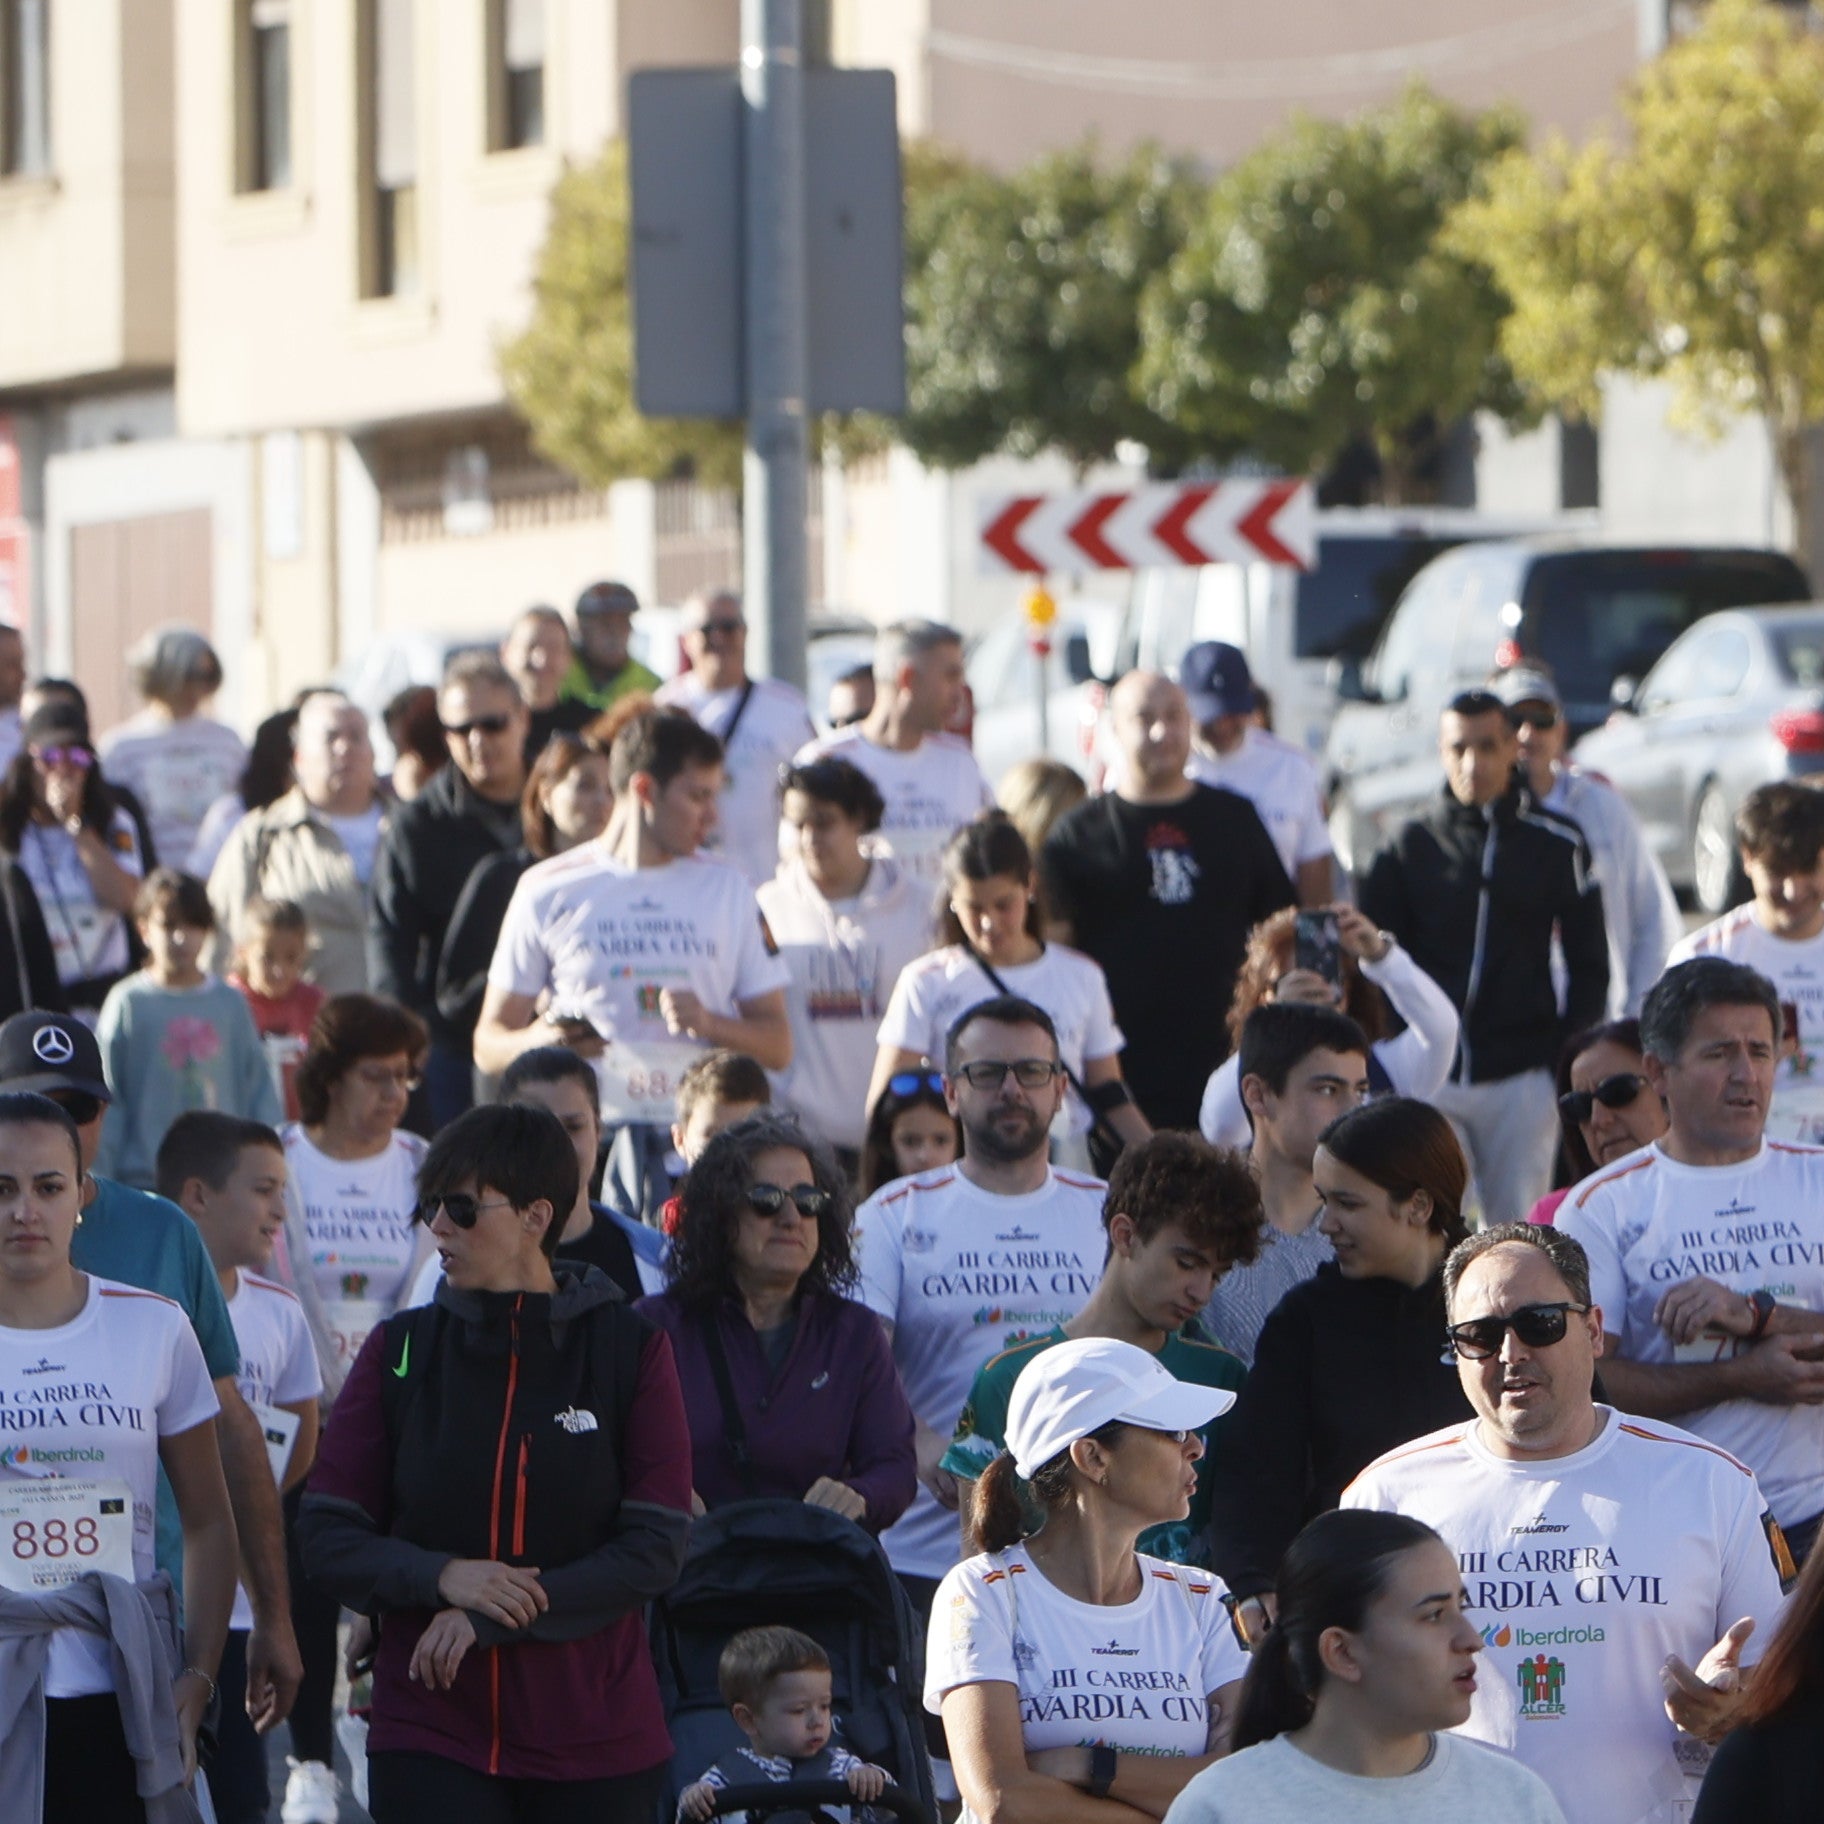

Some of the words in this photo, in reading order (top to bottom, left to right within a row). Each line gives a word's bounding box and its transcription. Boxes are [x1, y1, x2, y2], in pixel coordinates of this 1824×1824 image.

[306, 1222, 370, 1242] ARDIA
[376, 1222, 412, 1242] CIV
[1681, 1230, 1704, 1249] III
[1710, 1220, 1802, 1246] CARRERA
[957, 1251, 980, 1269] III
[987, 1251, 1084, 1270] CARRERA
[1650, 1249, 1761, 1282] GVARDIA
[922, 1272, 1040, 1298] GVARDIA
[1050, 1272, 1096, 1297] CIV
[13, 1381, 113, 1405] CARRERA
[0, 1406, 68, 1432] RDIA
[80, 1404, 146, 1432] CIVIL
[31, 1446, 105, 1464] Iberdrola
[12, 1516, 99, 1560] 888
[1510, 1524, 1570, 1535] TEAMERGY
[1459, 1551, 1487, 1574] III
[1497, 1546, 1621, 1575] CARRERA
[1461, 1578, 1562, 1612] ARDIA
[1575, 1575, 1669, 1606] CIVIL
[1516, 1624, 1605, 1647] Iberdrola
[1090, 1647, 1141, 1657] TEAMERGY
[1052, 1667, 1078, 1689] III
[1086, 1668, 1192, 1692] CARRERA
[1161, 1696, 1208, 1723] CIV
[1518, 1703, 1567, 1715] ALCER
